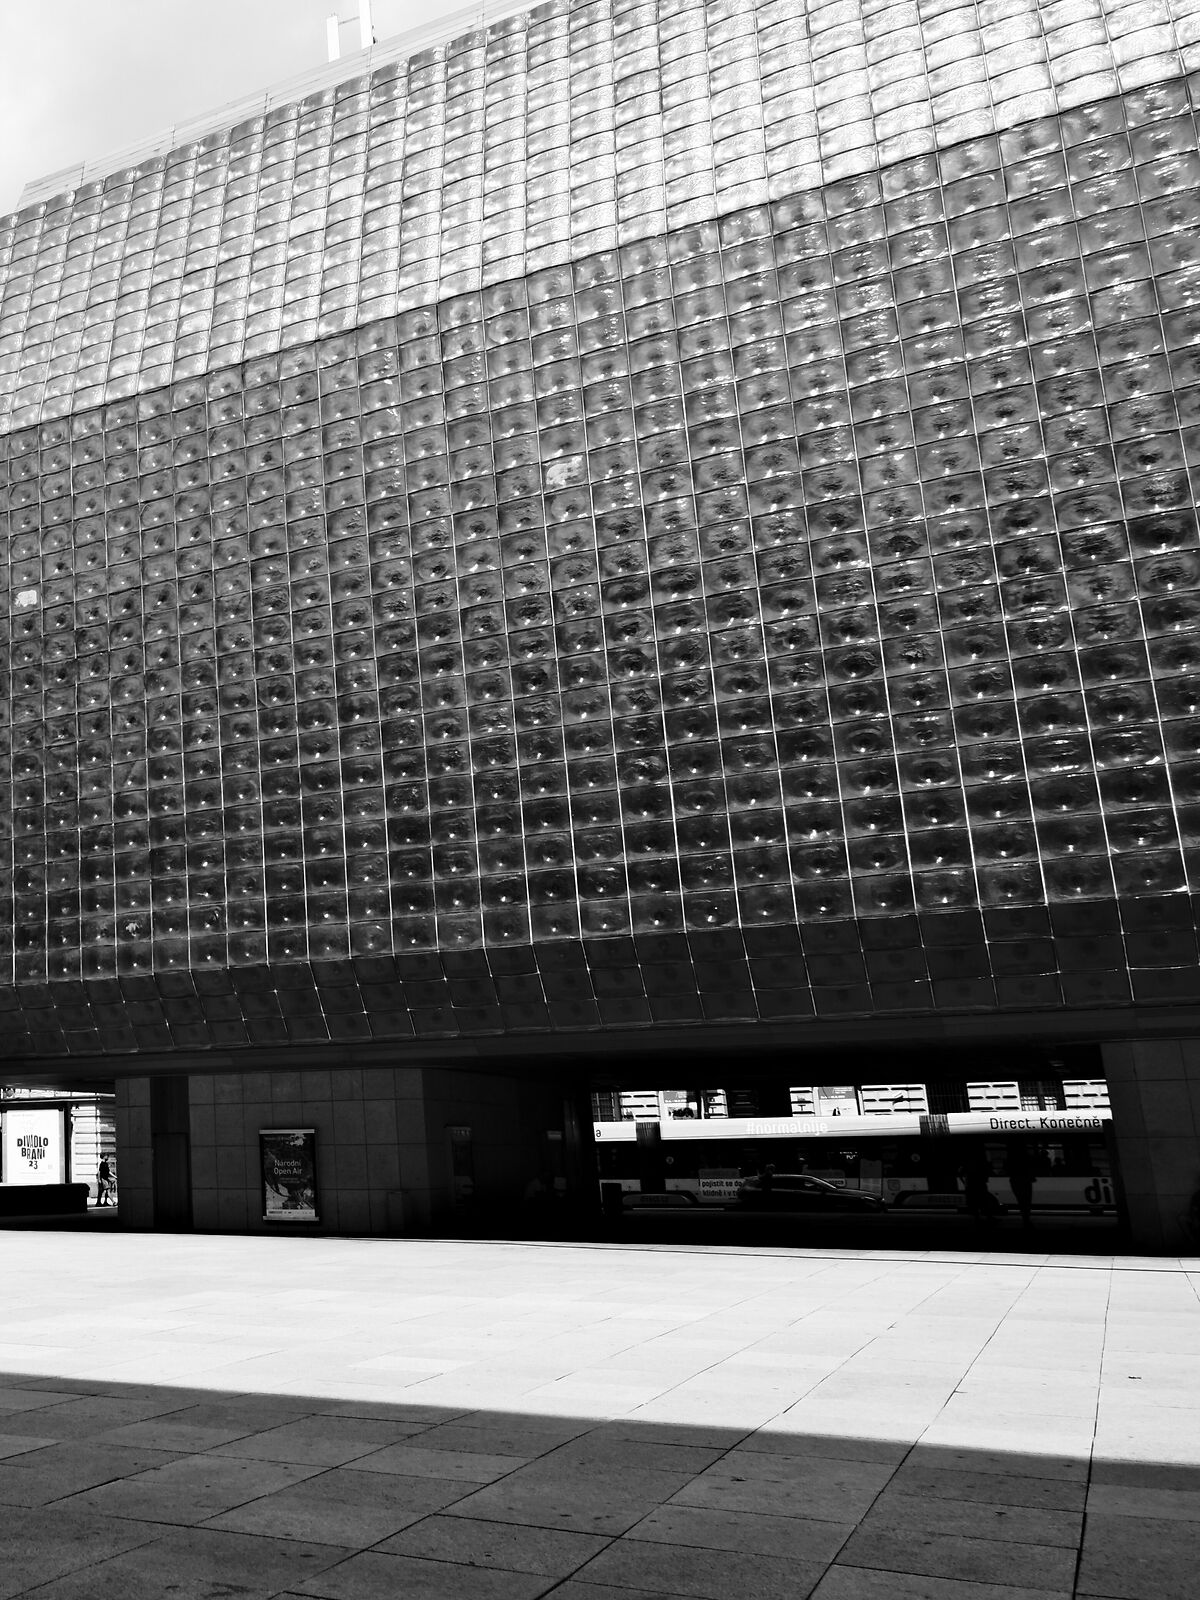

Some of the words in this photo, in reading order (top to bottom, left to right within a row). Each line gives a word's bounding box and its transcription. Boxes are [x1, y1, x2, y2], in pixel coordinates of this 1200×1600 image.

[990, 1117, 1036, 1130] Direct.
[17, 1134, 49, 1148] DIVADLO
[29, 1160, 38, 1170] 23
[273, 1167, 291, 1176] Open
[293, 1167, 303, 1175] Air
